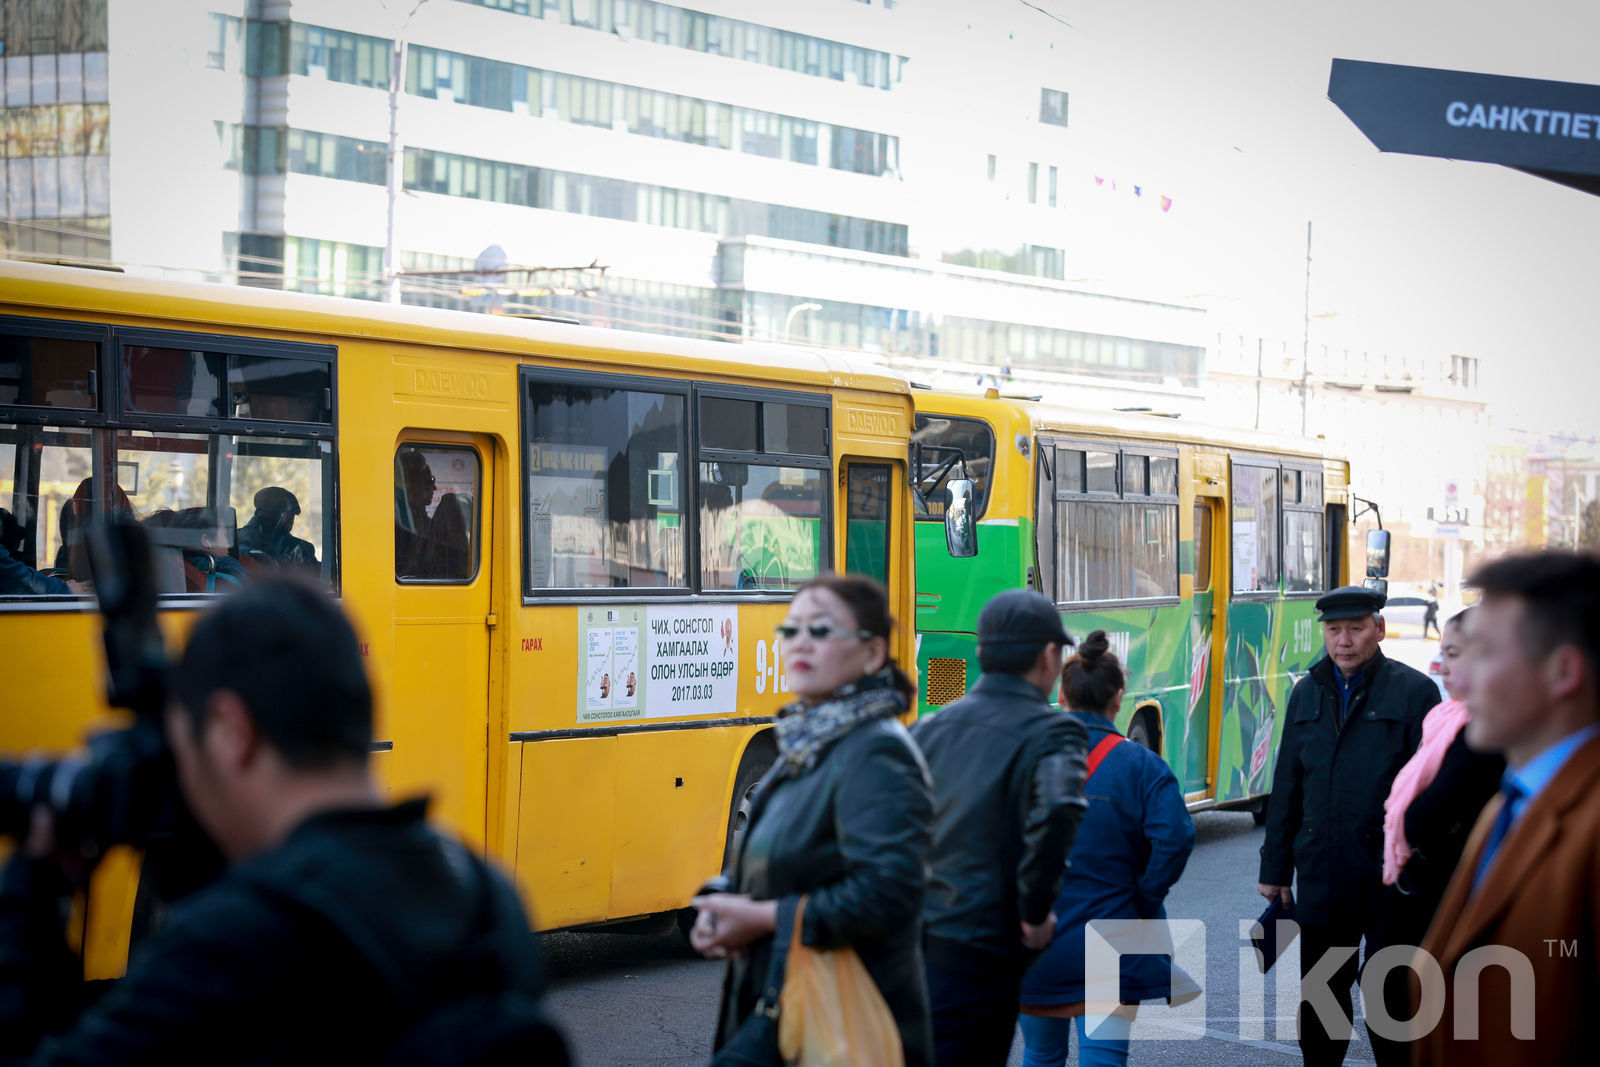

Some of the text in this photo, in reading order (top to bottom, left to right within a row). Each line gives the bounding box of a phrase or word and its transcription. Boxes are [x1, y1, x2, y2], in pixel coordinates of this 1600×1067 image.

[414, 368, 488, 399] DAEWOO
[847, 411, 897, 435] DAEWOO
[651, 617, 714, 637] ЧИХ, СОНСГОЛ
[521, 637, 543, 652] ГАРАХ
[656, 640, 709, 657] ХАМГААЛАХ
[651, 661, 734, 681] ОЛОН УЛСЫН ӨДӨР
[671, 684, 713, 702] 2017.03.03
